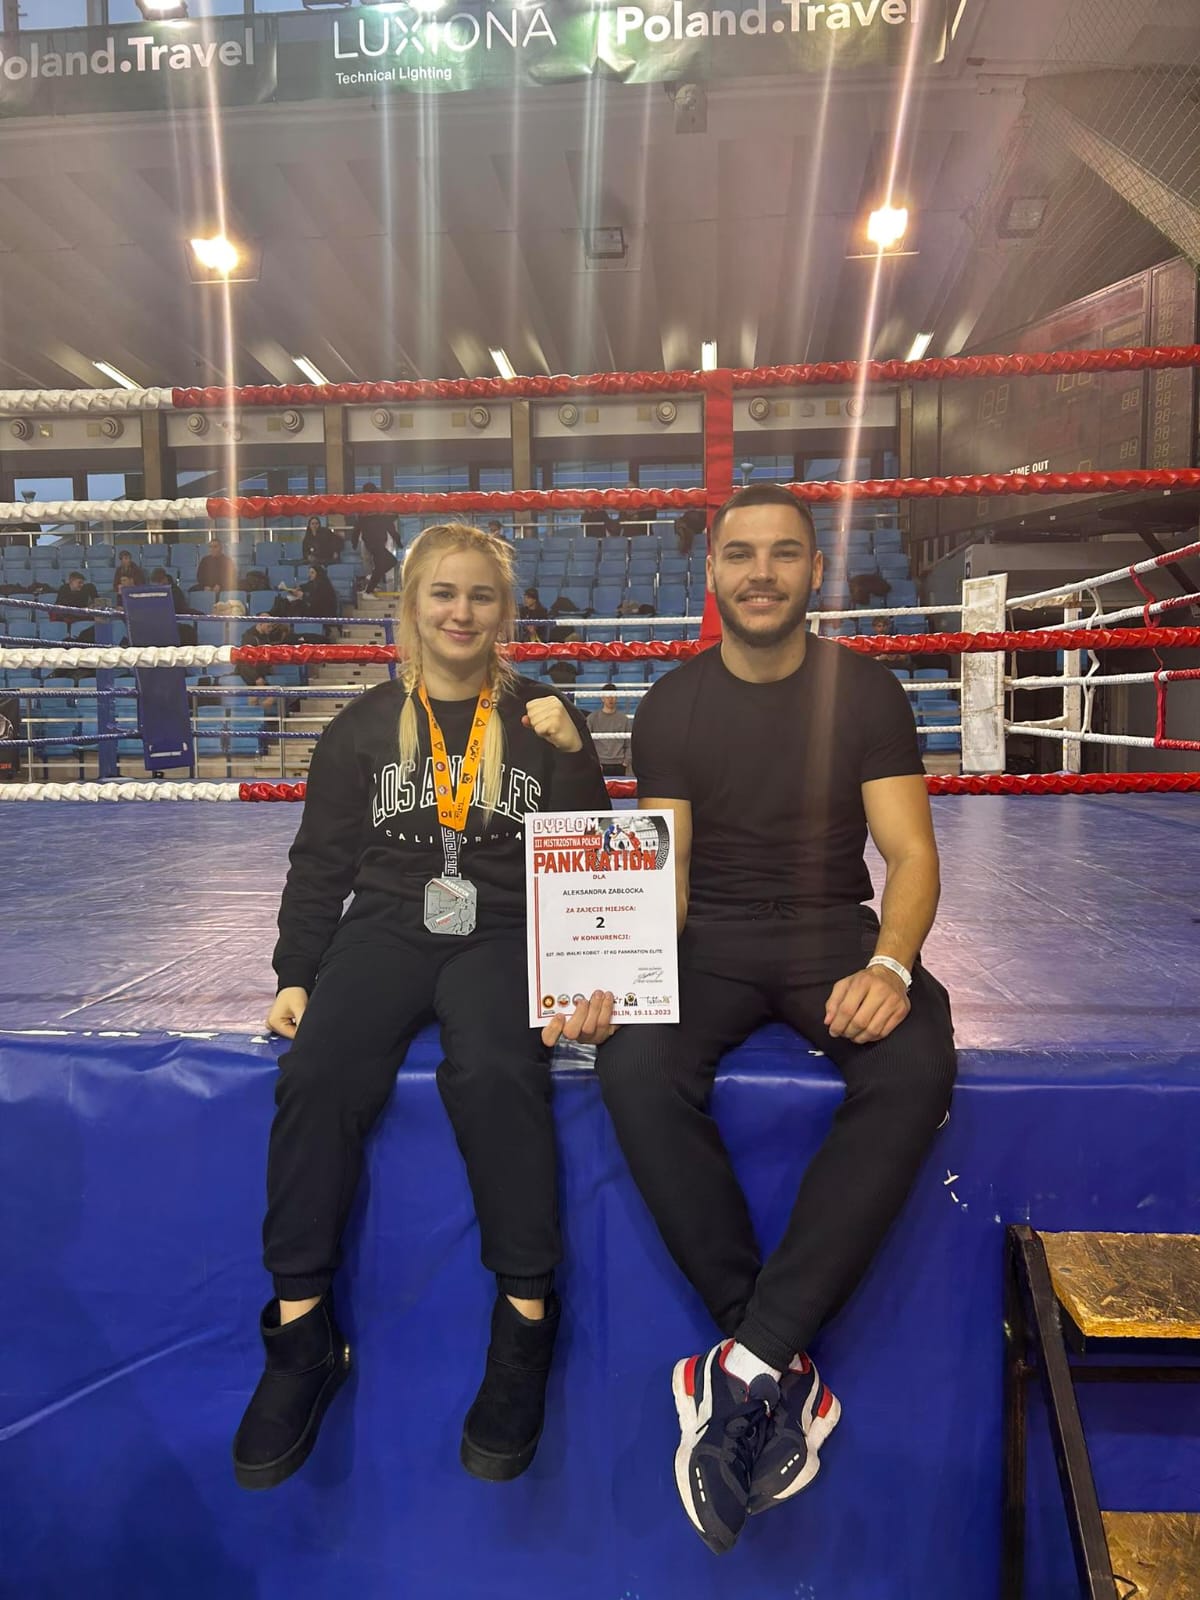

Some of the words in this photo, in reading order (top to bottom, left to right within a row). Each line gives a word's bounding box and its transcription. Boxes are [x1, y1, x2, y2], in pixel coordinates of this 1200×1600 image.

[334, 7, 558, 59] LUXIONA
[0, 27, 255, 81] oland.Travel
[335, 68, 396, 85] Technical
[399, 67, 453, 81] Lighting
[1032, 460, 1049, 473] OUT
[533, 817, 599, 834] DYPLOM
[535, 839, 543, 849] III
[543, 837, 581, 848] MISTRZOSTWA
[581, 836, 601, 847] POLSKI
[534, 849, 657, 874] PANKRATION
[562, 888, 607, 896] ALEKSANDRA
[608, 887, 644, 895] ZABŁOCKA
[595, 917, 606, 929] 2
